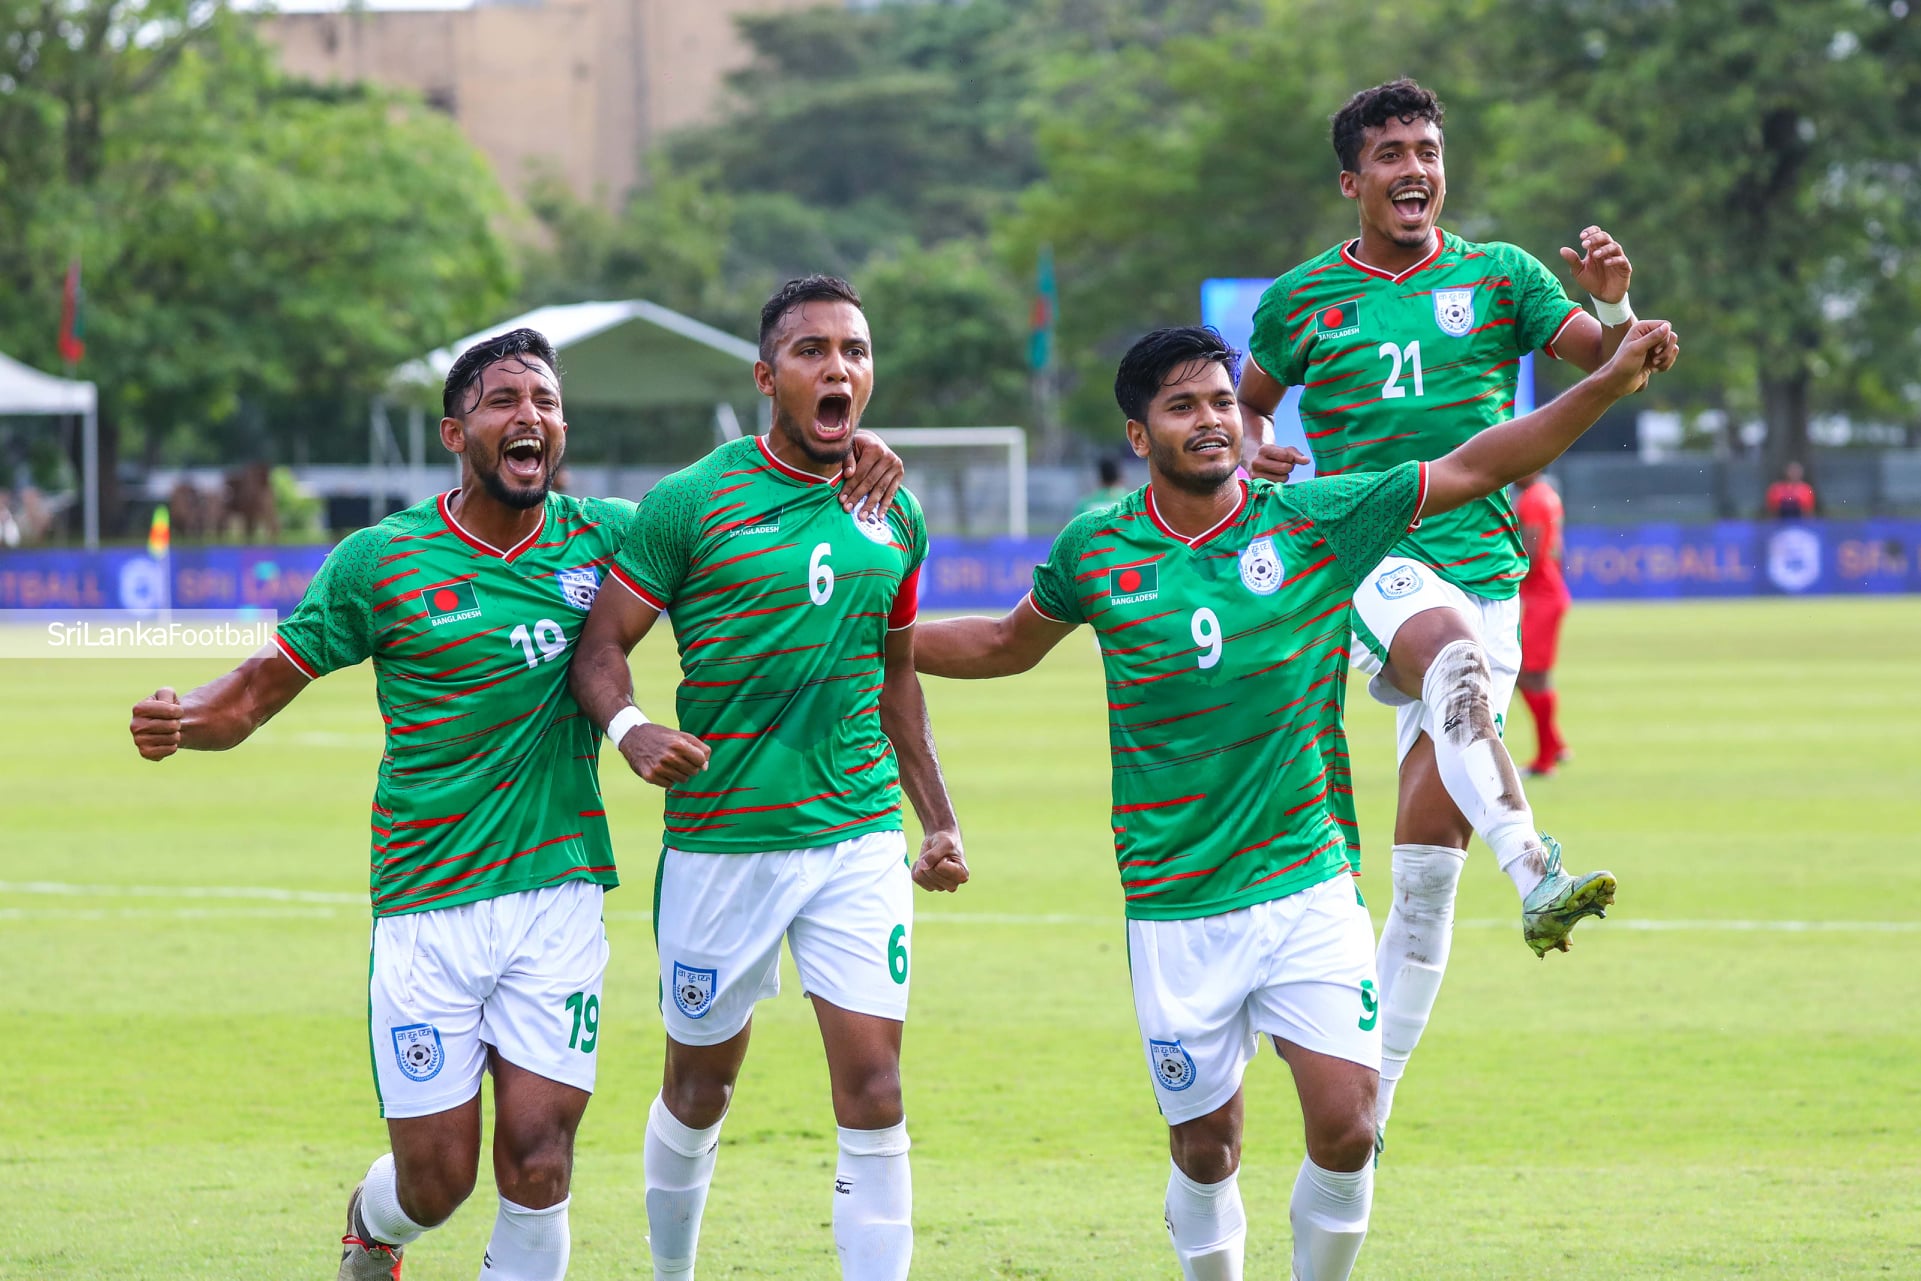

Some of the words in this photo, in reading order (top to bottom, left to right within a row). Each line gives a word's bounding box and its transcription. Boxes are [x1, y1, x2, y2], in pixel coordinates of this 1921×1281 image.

[1379, 340, 1424, 399] 21
[808, 542, 835, 606] 6
[1111, 592, 1158, 606] BANGLADESH
[431, 609, 482, 627] BANGLADESH
[509, 618, 567, 669] 19
[1191, 607, 1223, 669] 9
[888, 924, 908, 985] 6
[565, 991, 599, 1053] 19
[1358, 979, 1378, 1031] 9
